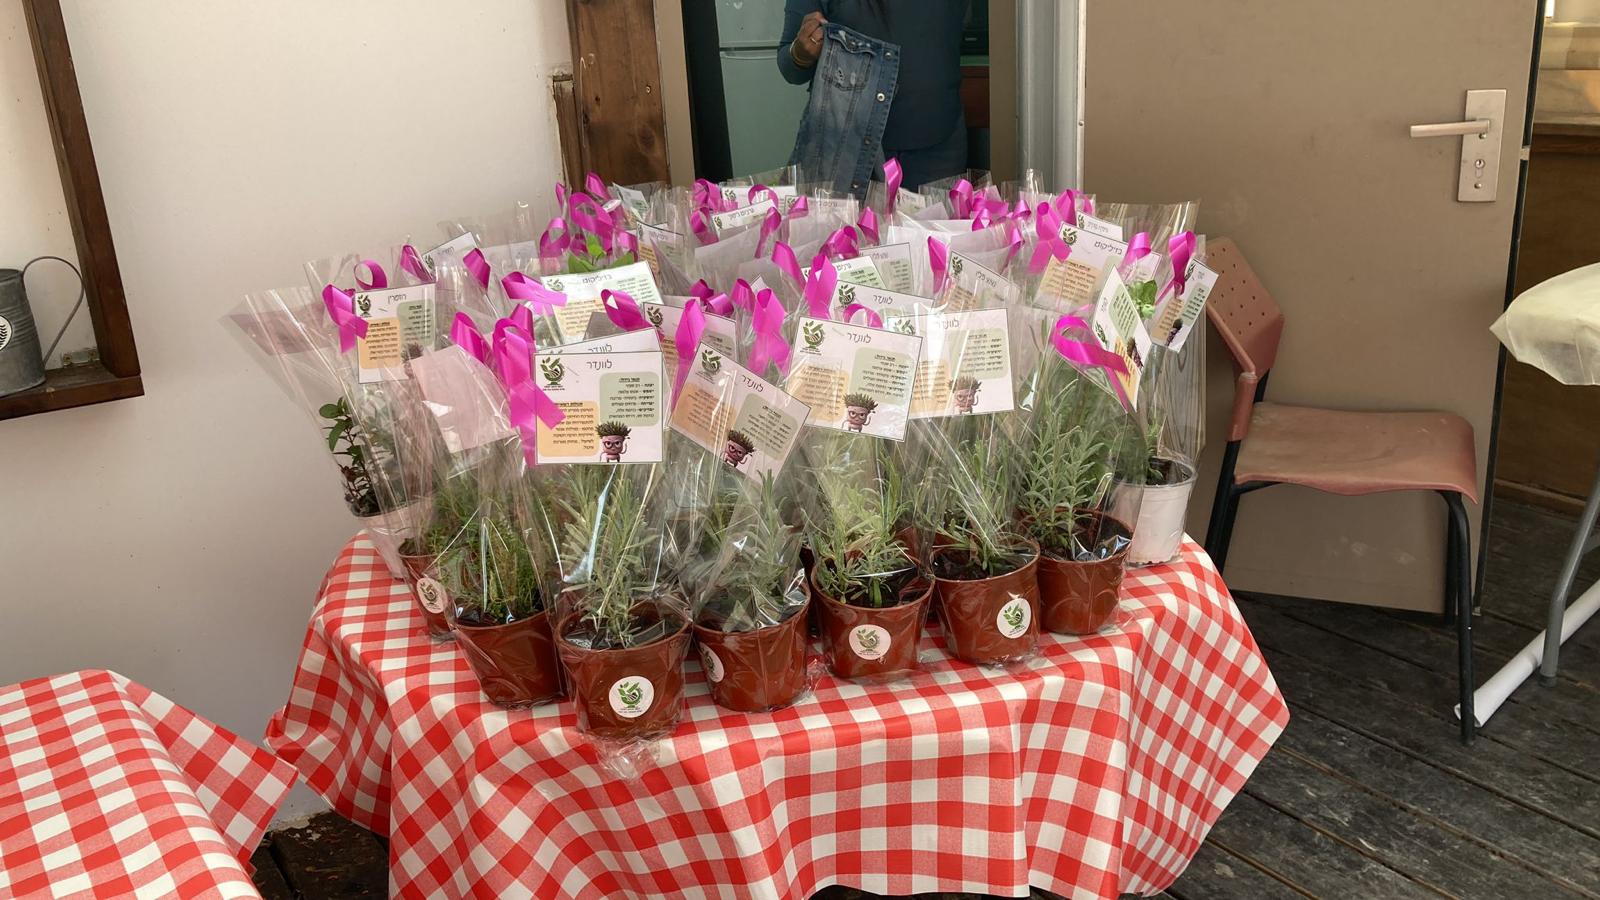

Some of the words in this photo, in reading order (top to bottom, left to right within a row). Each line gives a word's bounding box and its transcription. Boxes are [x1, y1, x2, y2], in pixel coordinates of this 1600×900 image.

[1094, 240, 1123, 255] בזיליקום
[873, 294, 894, 305] לוונדר
[846, 331, 872, 344] לוונדר
[586, 358, 613, 371] לוונדר
[742, 374, 765, 393] לוונדר
